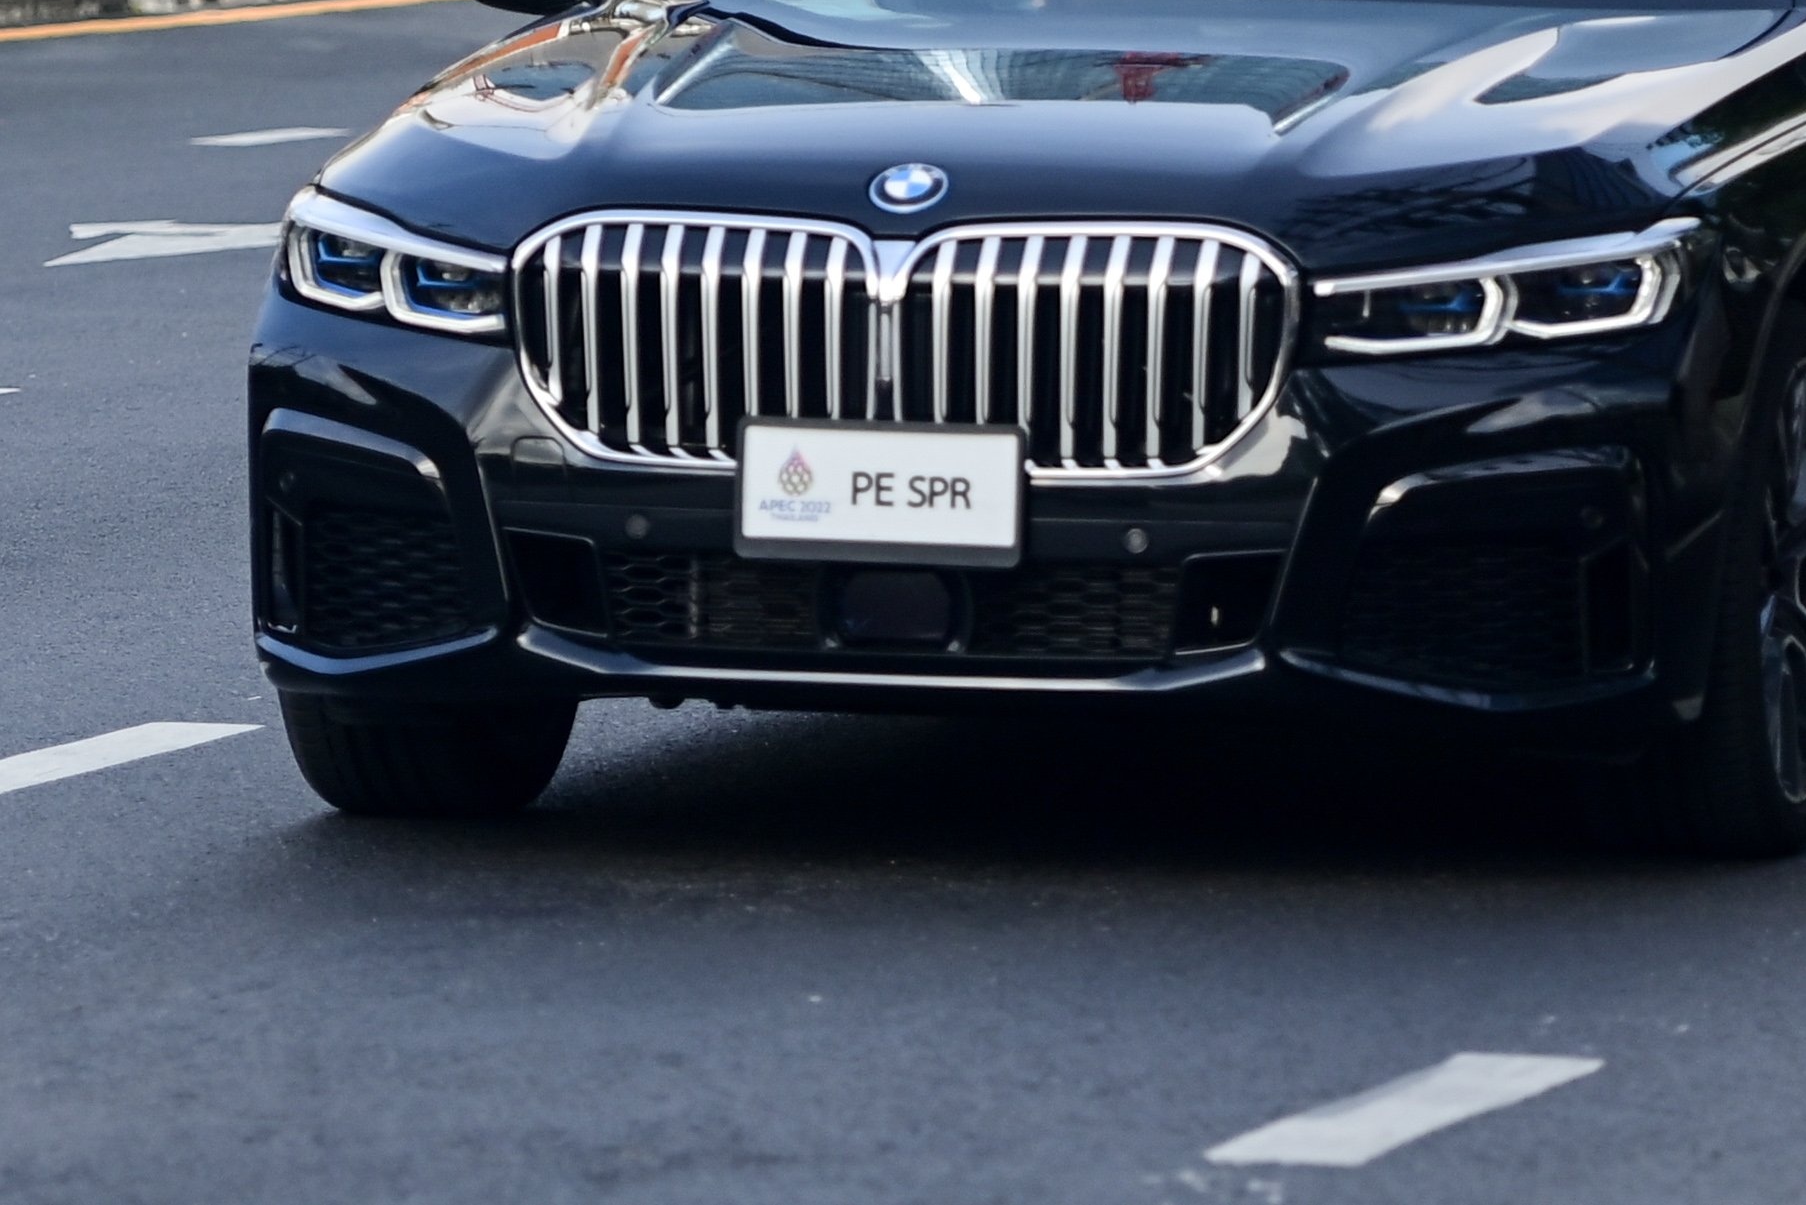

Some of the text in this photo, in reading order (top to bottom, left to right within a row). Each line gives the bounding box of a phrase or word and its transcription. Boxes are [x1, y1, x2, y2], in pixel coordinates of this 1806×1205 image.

[851, 471, 972, 510] PE SPR
[759, 499, 832, 514] APEC 2022
